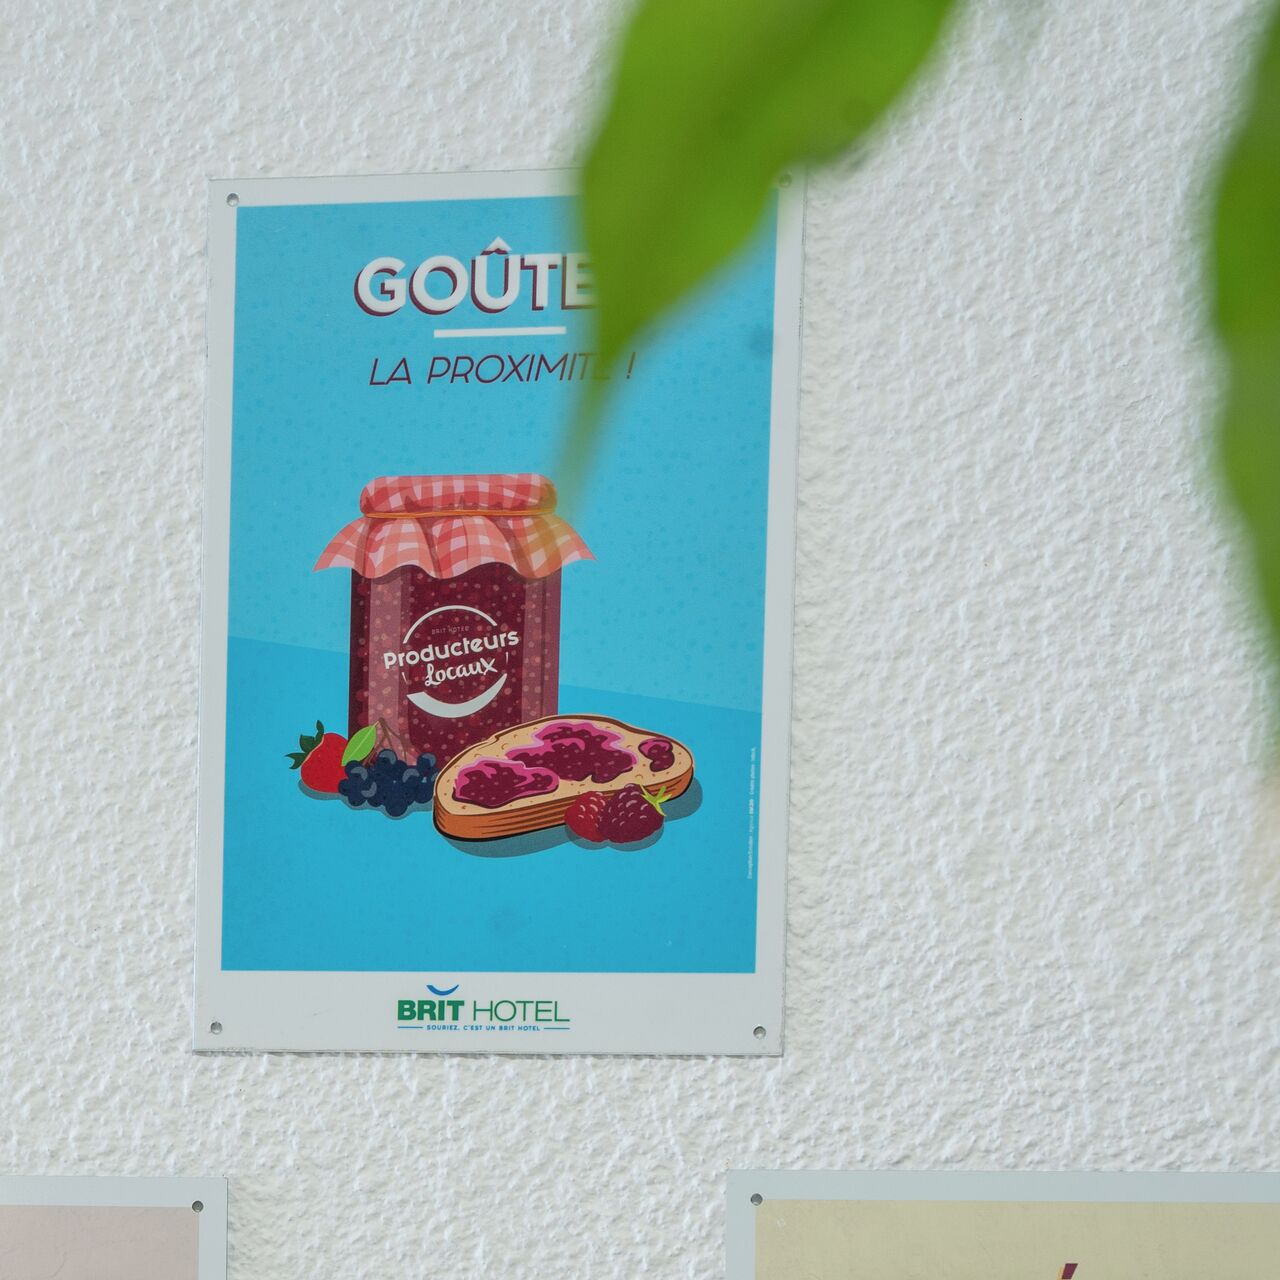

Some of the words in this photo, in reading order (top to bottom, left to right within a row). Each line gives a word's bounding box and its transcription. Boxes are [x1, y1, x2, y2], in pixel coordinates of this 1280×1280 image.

[354, 236, 598, 317] GOÛTE
[369, 357, 412, 386] LA
[625, 351, 637, 380] !
[383, 631, 520, 669] Producteurs
[424, 657, 498, 687] Locaux
[397, 1000, 465, 1021] BRIT
[473, 1000, 571, 1022] HOTEL
